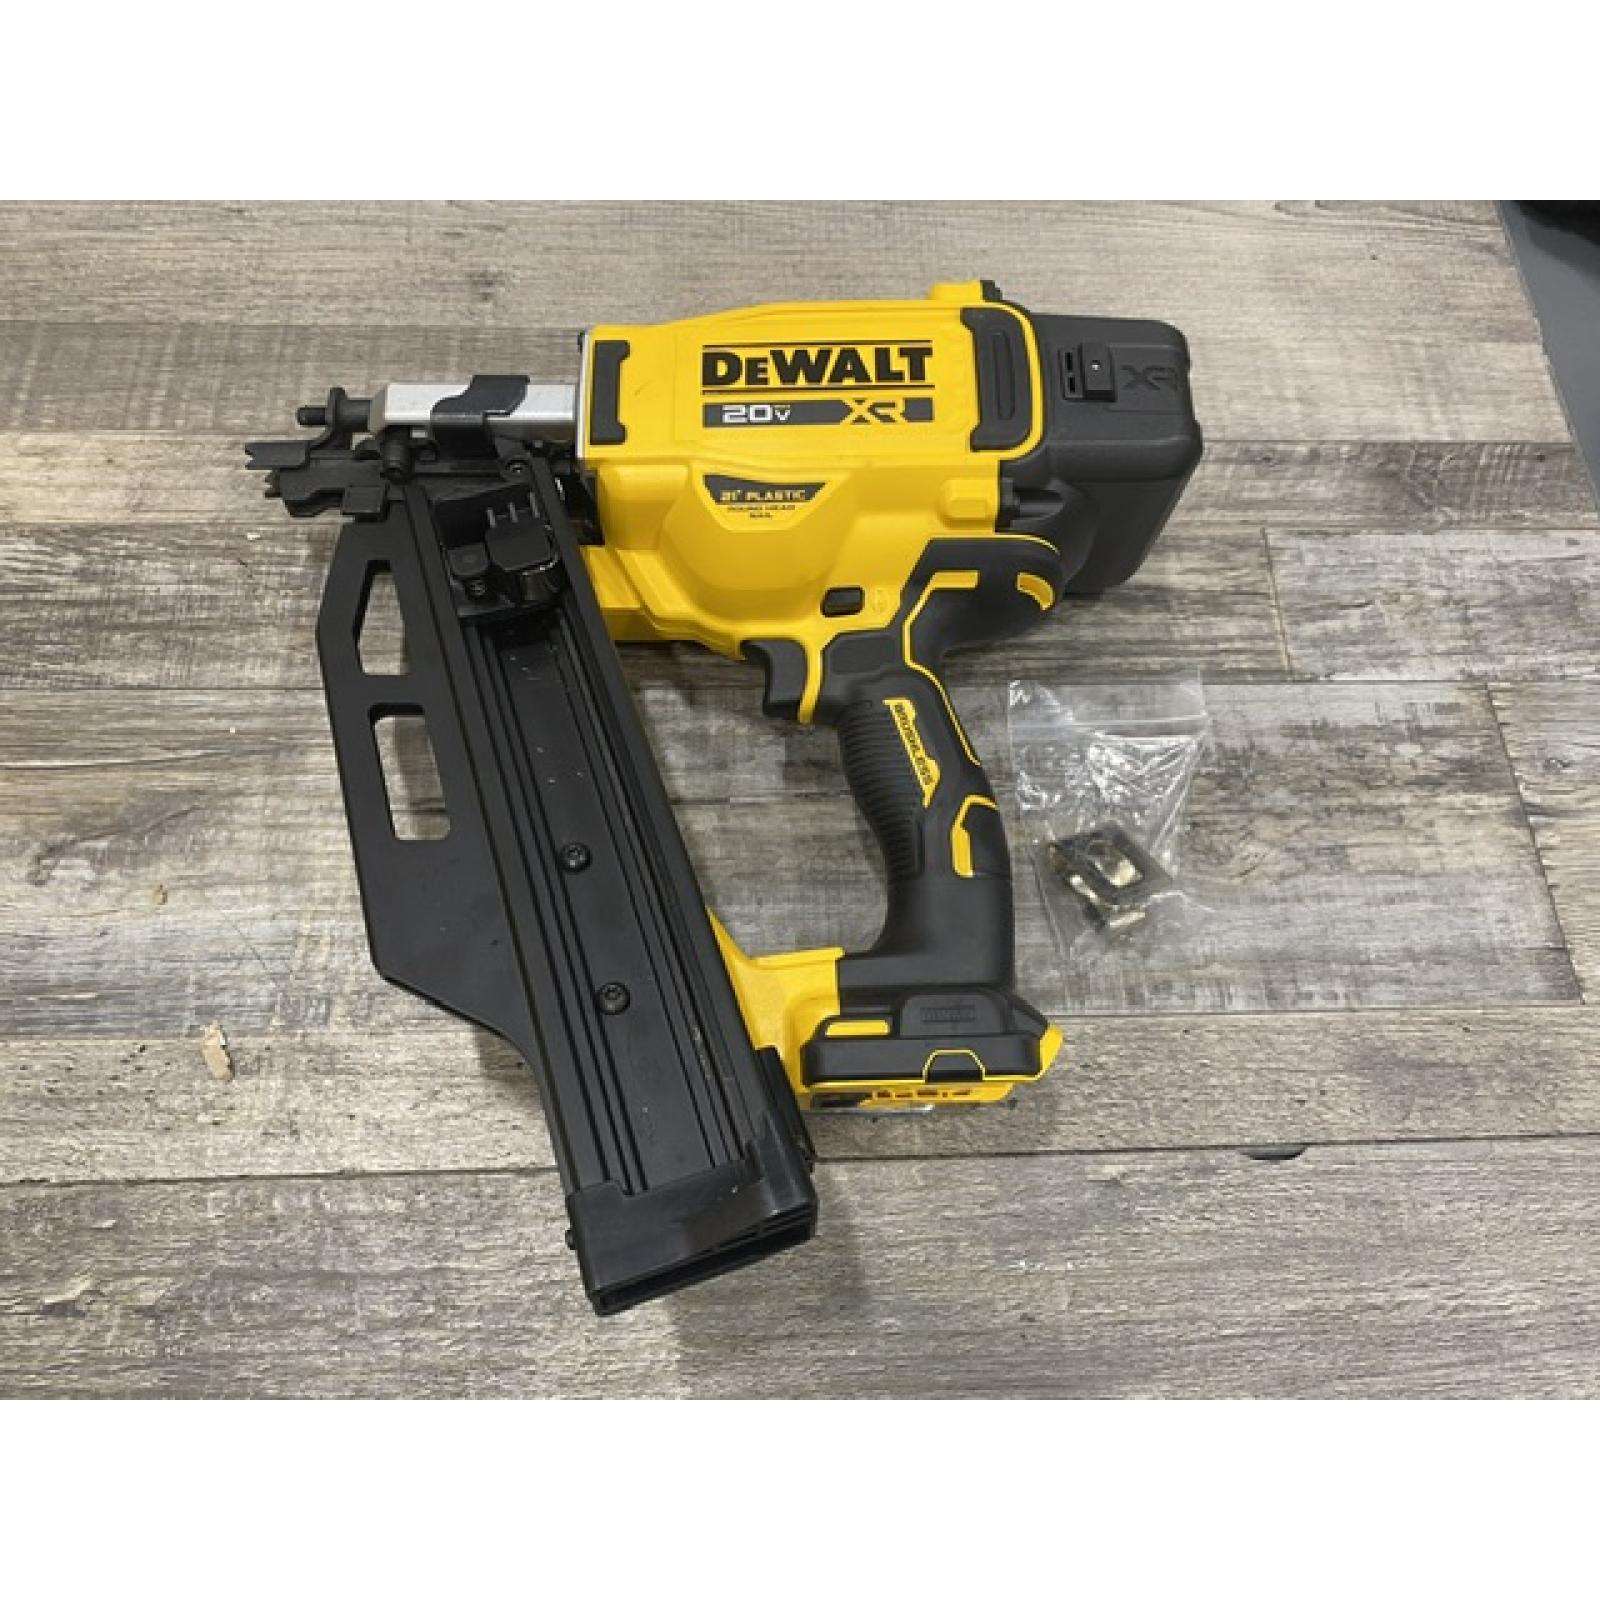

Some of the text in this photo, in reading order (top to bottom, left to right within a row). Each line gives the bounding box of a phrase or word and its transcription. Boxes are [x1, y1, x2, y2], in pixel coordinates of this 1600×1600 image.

[702, 347, 933, 386] DEWALT
[840, 398, 909, 424] XR
[745, 489, 806, 501] PLASTIC
[894, 703, 934, 786] BRUSHLESS
